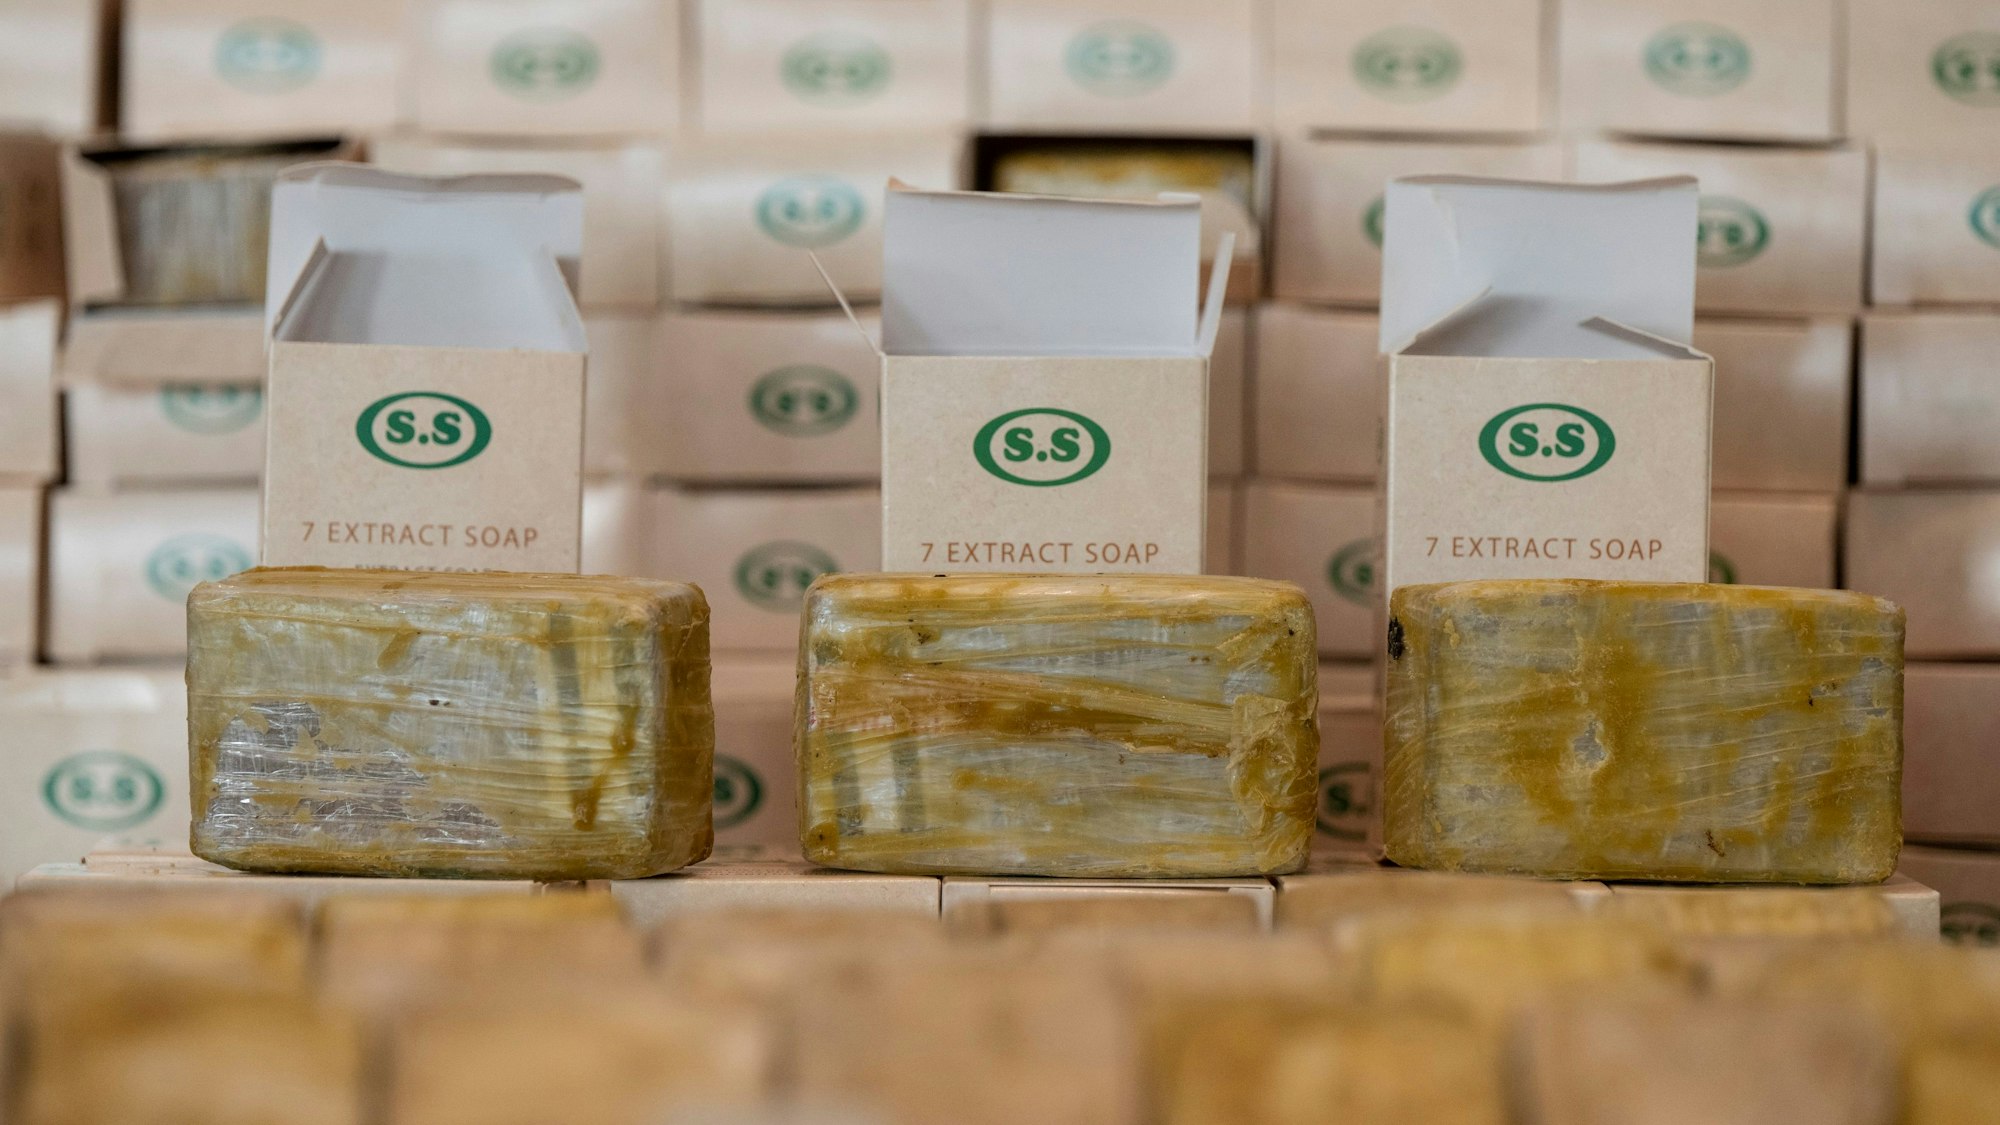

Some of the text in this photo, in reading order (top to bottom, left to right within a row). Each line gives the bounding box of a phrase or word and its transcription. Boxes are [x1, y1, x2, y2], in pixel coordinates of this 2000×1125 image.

[385, 410, 462, 446] S.S
[1507, 422, 1585, 458] S.S
[1003, 427, 1081, 463] S.S
[302, 521, 539, 548] 7 EXTRACT SOAP
[1426, 536, 1664, 561] 7 EXTRACT SOAP
[921, 542, 1159, 564] 7 EXTRACT SOAP
